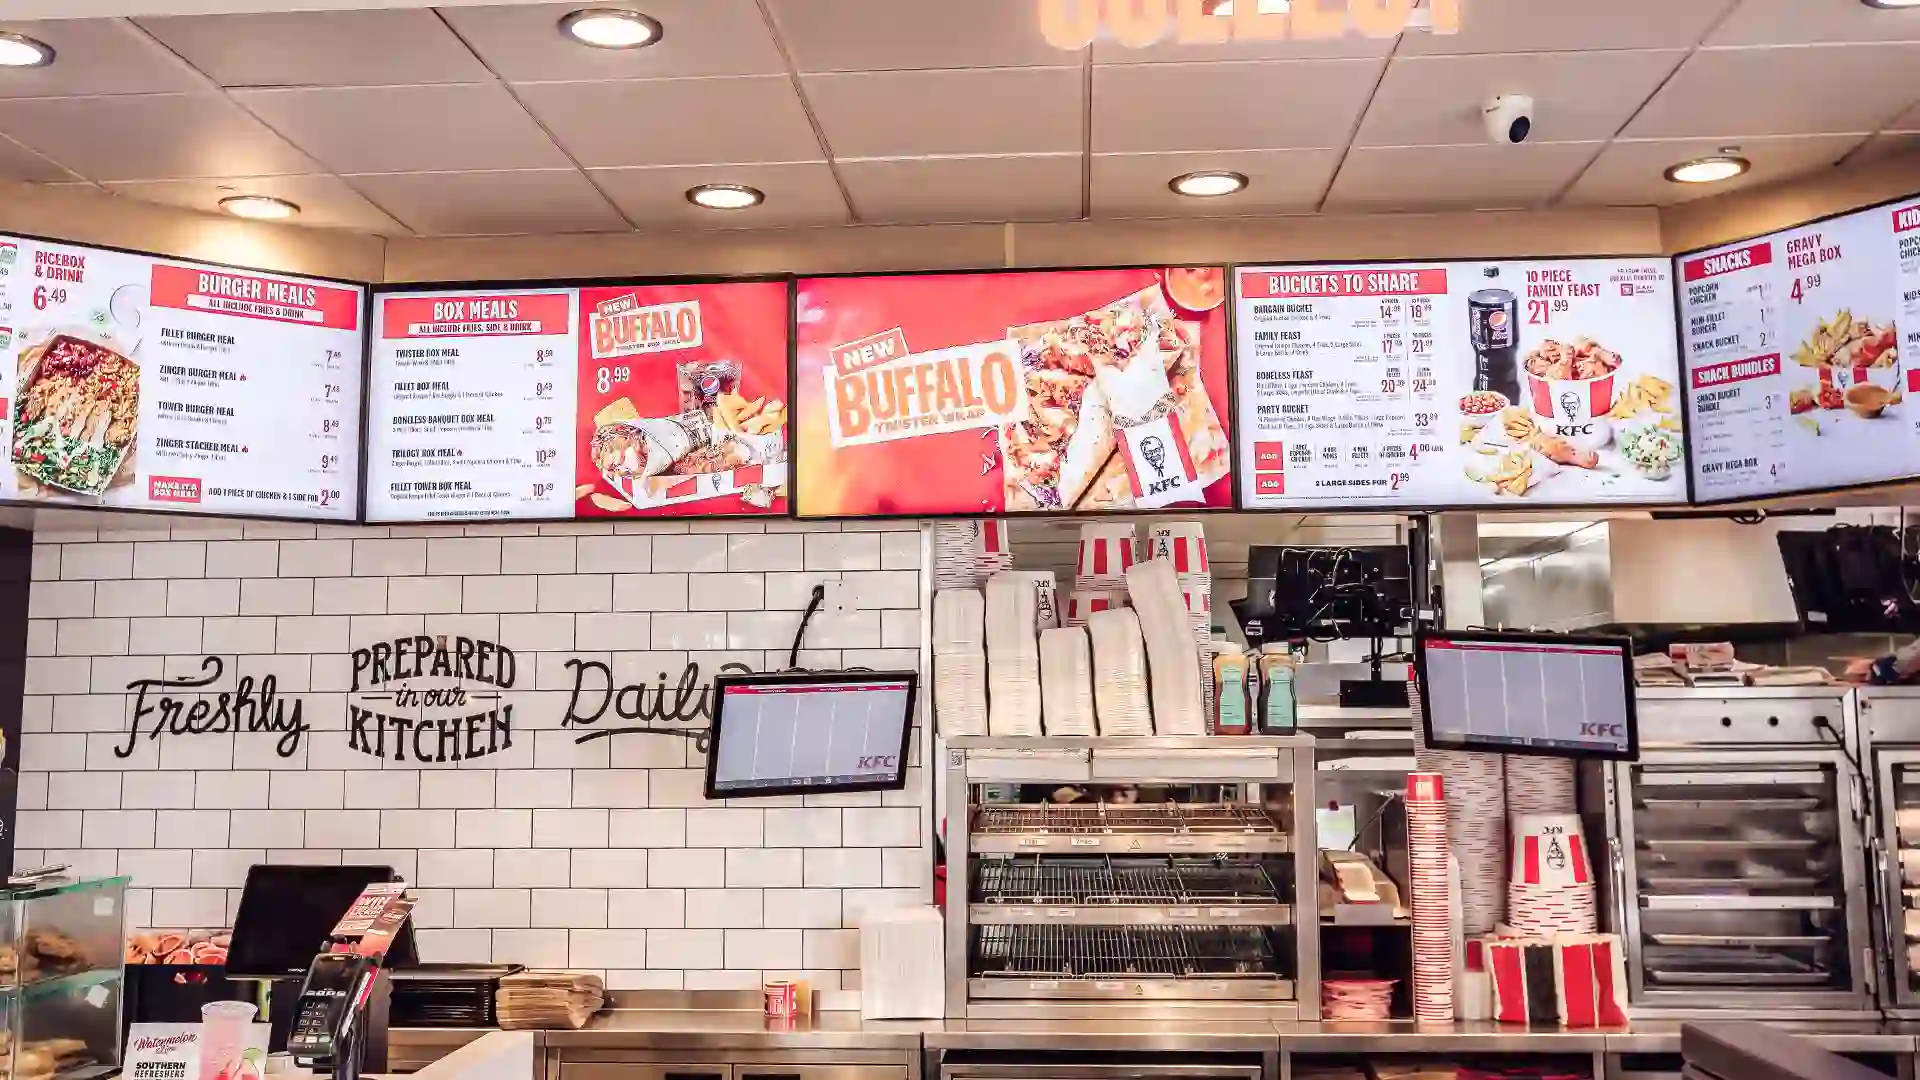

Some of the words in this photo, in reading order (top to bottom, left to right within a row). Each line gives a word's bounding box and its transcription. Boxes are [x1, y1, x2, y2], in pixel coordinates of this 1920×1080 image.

[1786, 234, 1822, 254] GRAVY
[35, 251, 85, 269] RICEBOX
[1704, 249, 1751, 276] SNACKS
[1788, 251, 1816, 270] MEGA
[1820, 245, 1842, 262] BOX
[35, 265, 43, 277] &
[46, 266, 84, 283] DRINK
[1526, 270, 1538, 283] 10
[1541, 270, 1572, 282] PIECE
[198, 274, 261, 299] BURGER
[267, 283, 316, 307] MEALS
[1269, 275, 1340, 295] BUCKETS
[1343, 275, 1363, 293] TO
[1368, 273, 1419, 292] SHARE
[1527, 284, 1564, 297] FAMILY
[1568, 283, 1600, 297] FEAST
[1689, 282, 1719, 296] POPCORN
[33, 285, 67, 310] 6.49
[1689, 293, 1717, 305] CHICKEN
[208, 299, 220, 308] ALL
[223, 300, 253, 312] INCLUDE
[254, 304, 274, 315] FRIES
[275, 306, 281, 315] &
[282, 307, 304, 319] DRINK
[434, 302, 465, 320] BOX
[469, 300, 518, 320] MEALS
[604, 299, 631, 315] NEW
[1254, 304, 1284, 314] BARGAIN
[1286, 304, 1313, 313] BUCKET
[1528, 300, 1569, 324] 21.99
[1691, 316, 1705, 326] MINI
[1706, 312, 1725, 323] FILLET
[419, 324, 430, 333] ALL
[432, 324, 460, 333] INCLUDE
[486, 323, 501, 332] SIDE
[503, 323, 509, 331] &
[510, 323, 532, 331] DRINK
[595, 307, 696, 353] BUFFALO
[1254, 331, 1279, 341] FAMILY
[1280, 331, 1301, 340] FEAST
[1692, 322, 1717, 335] BURGER
[161, 328, 184, 339] FILLET
[186, 330, 216, 342] BURGER
[217, 334, 235, 345] MEAL
[1692, 339, 1714, 352] SNACK
[1715, 334, 1739, 347] BUCKET
[395, 349, 425, 359] TWISTER
[426, 349, 440, 357] BOX
[441, 348, 460, 357] MEAL
[843, 338, 896, 370] NEW
[159, 365, 186, 377] ZINGER
[188, 367, 219, 379] BURGER
[219, 369, 237, 381] MEAL
[1256, 371, 1291, 380] BONELESS
[1292, 370, 1313, 379] FEAST
[1698, 366, 1730, 384] SNACK
[1732, 358, 1775, 378] BUNDLES
[394, 382, 415, 391] FILLET
[416, 382, 431, 391] BOX
[432, 381, 450, 391] MEAL
[596, 367, 631, 394] 8.99
[836, 352, 1017, 438] BUFFALO
[158, 401, 184, 412] TOWER
[185, 403, 215, 415] BURGER
[216, 405, 235, 417] MEAL
[1257, 405, 1280, 414] PARTY
[1282, 404, 1309, 414] BUCKET
[392, 415, 427, 425] BONELESS
[428, 415, 460, 424] BANQUET
[461, 414, 475, 423] BOX
[476, 414, 494, 423] MEAL
[1556, 423, 1594, 436] KFC
[156, 437, 184, 449] ZINGER
[184, 440, 219, 452] STACKER
[220, 442, 238, 453] MEAL
[1409, 443, 1430, 460] 4.00
[391, 449, 420, 459] TRILOGY
[422, 449, 436, 457] BOX
[437, 448, 456, 457] MEAL
[1702, 462, 1725, 474] GRAVY
[1725, 459, 1743, 470] MEGA
[1744, 458, 1758, 468] BOX
[390, 482, 412, 491] FILLET
[413, 482, 437, 491] TOWER
[438, 482, 453, 491] BOX
[454, 481, 472, 490] MEAL
[1148, 474, 1181, 497] KFC
[1261, 480, 1279, 488] ADD
[1391, 472, 1410, 490] 2.99
[208, 487, 222, 496] ADD
[228, 488, 245, 498] PIECE
[246, 490, 254, 498] OF
[255, 490, 281, 500] CHICKEN
[282, 492, 287, 500] &
[292, 493, 307, 501] SIDE
[307, 494, 319, 503] FOR
[320, 489, 340, 506] 2.00
[350, 635, 516, 692] PREPARED
[395, 683, 418, 708] in
[424, 688, 467, 707] our
[114, 656, 310, 758] Freshly
[348, 703, 513, 763] KITCHEN
[1579, 721, 1624, 737] KFC
[856, 755, 897, 769] KFC
[133, 1031, 198, 1051] Watermelon
[134, 1069, 185, 1078] REFRESHERS
[136, 1061, 187, 1070] SOUTHERN
